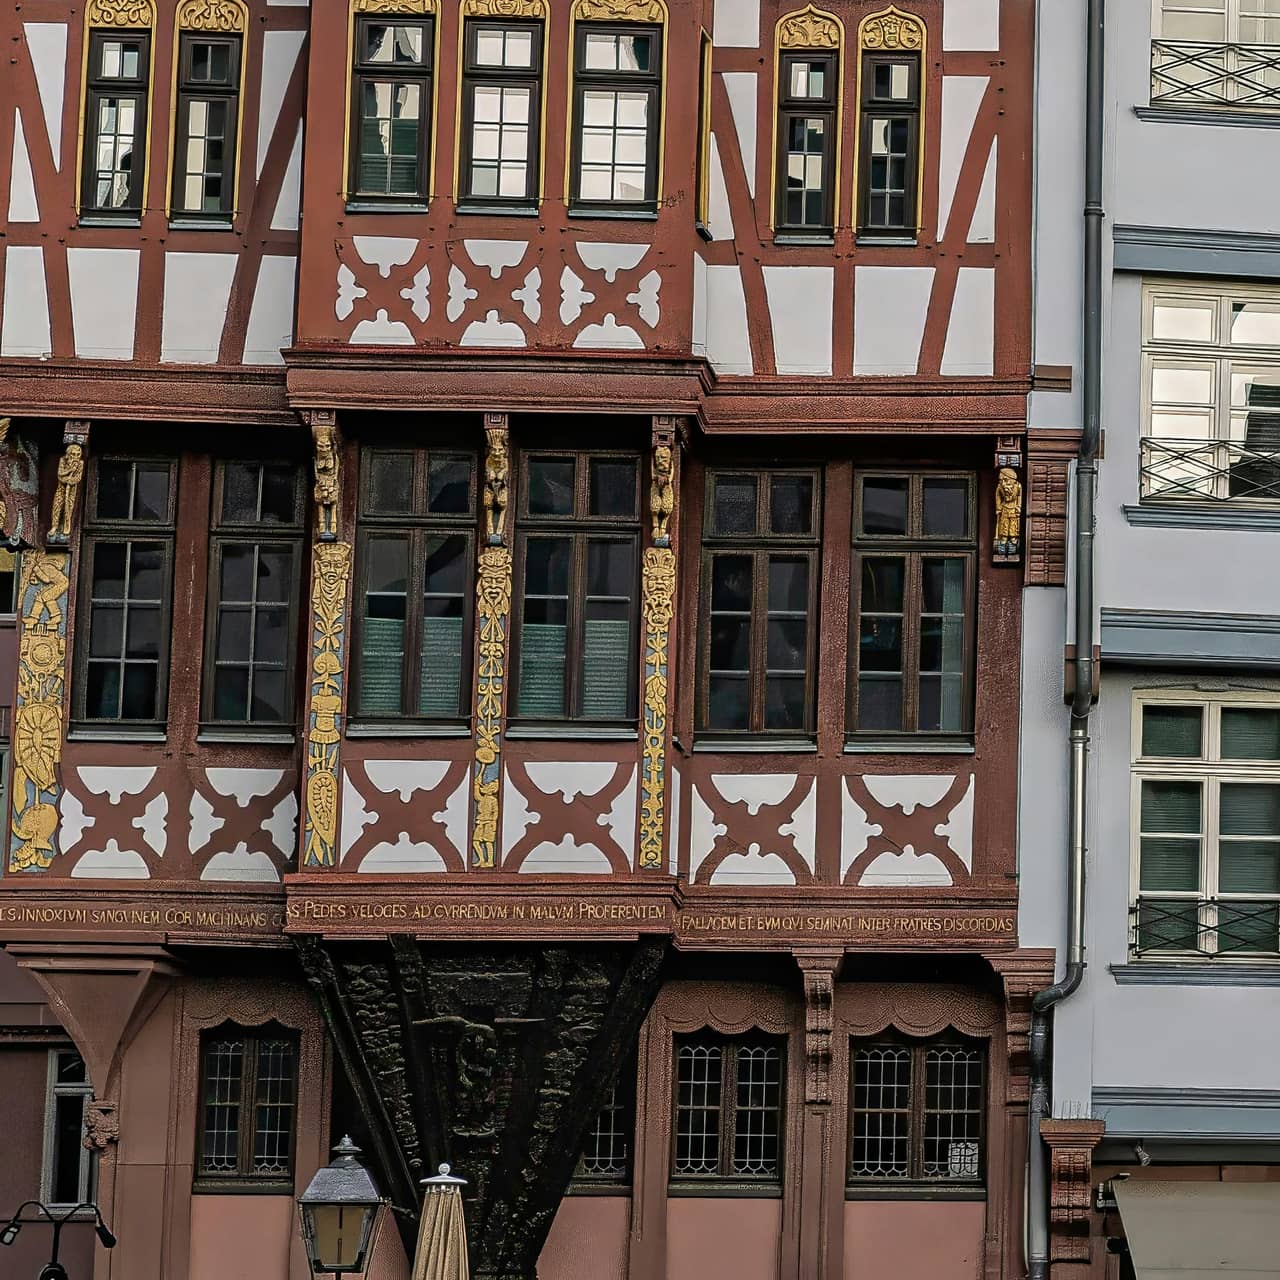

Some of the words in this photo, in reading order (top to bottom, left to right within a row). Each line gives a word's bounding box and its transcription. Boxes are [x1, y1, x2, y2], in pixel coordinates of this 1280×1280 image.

[165, 907, 192, 925] COR
[413, 904, 431, 919] AD
[513, 904, 524, 919] IN
[944, 917, 1014, 933] DISCORDIAS
